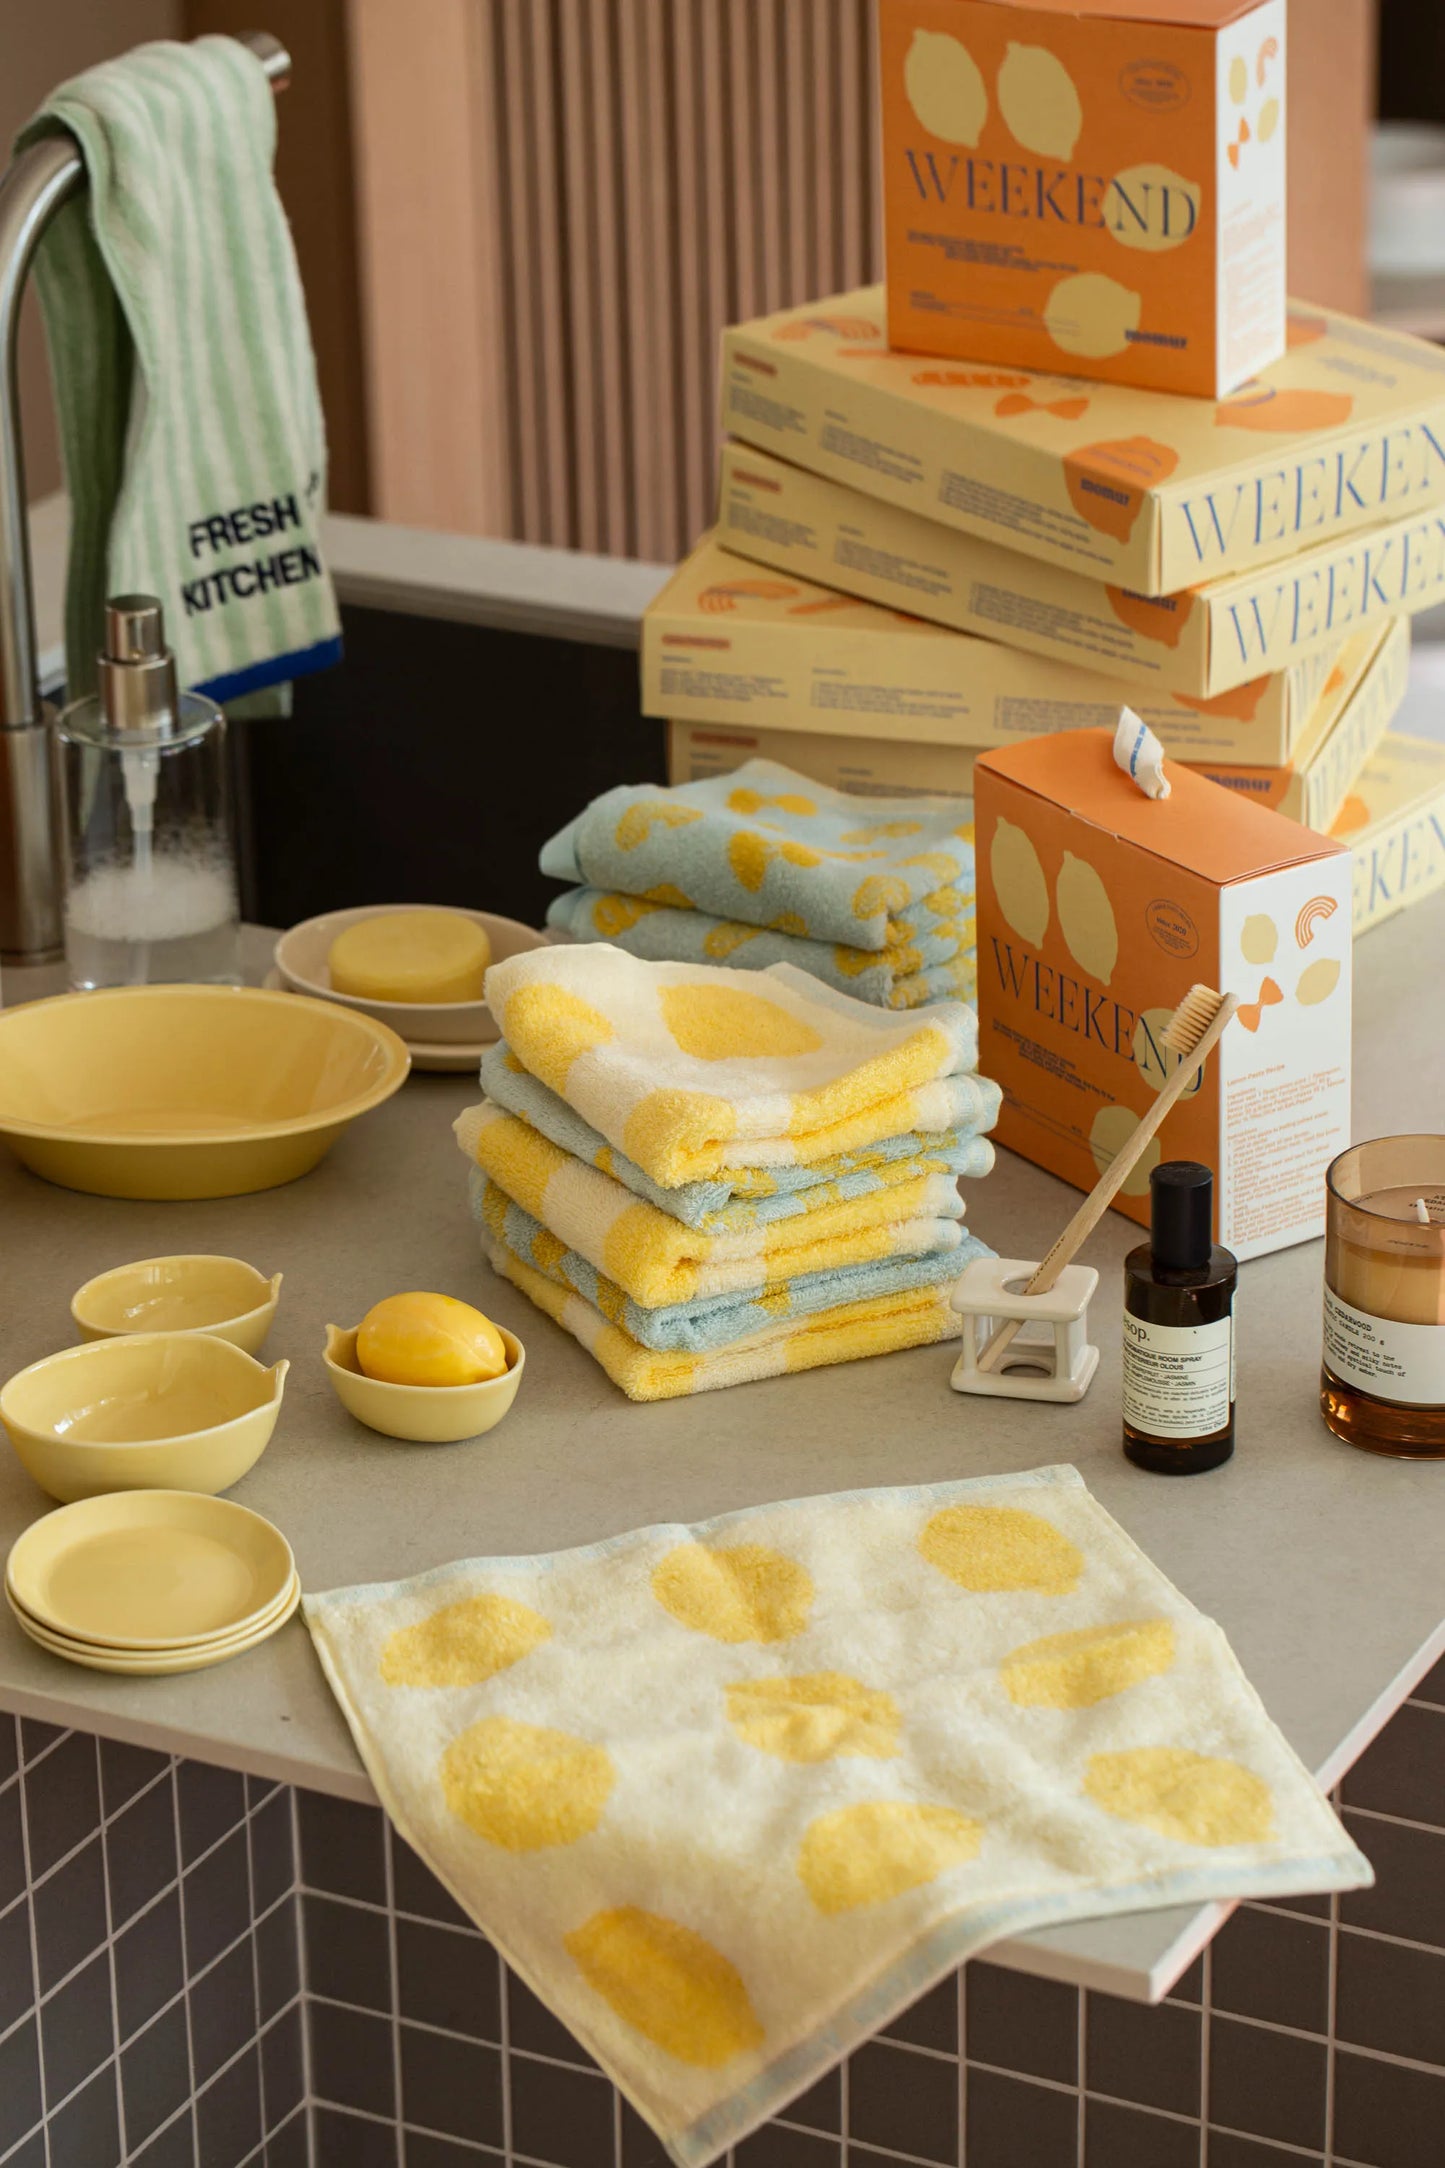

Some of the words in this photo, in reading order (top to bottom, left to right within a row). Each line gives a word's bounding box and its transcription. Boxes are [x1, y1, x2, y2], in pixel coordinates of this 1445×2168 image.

[906, 149, 1197, 237] WEEKEND
[189, 493, 302, 559] FRESH
[181, 545, 321, 617] KITCHEN
[1158, 1354, 1179, 1363] ROOM
[1180, 1355, 1202, 1363] SPRAY
[1362, 1333, 1376, 1342] 200
